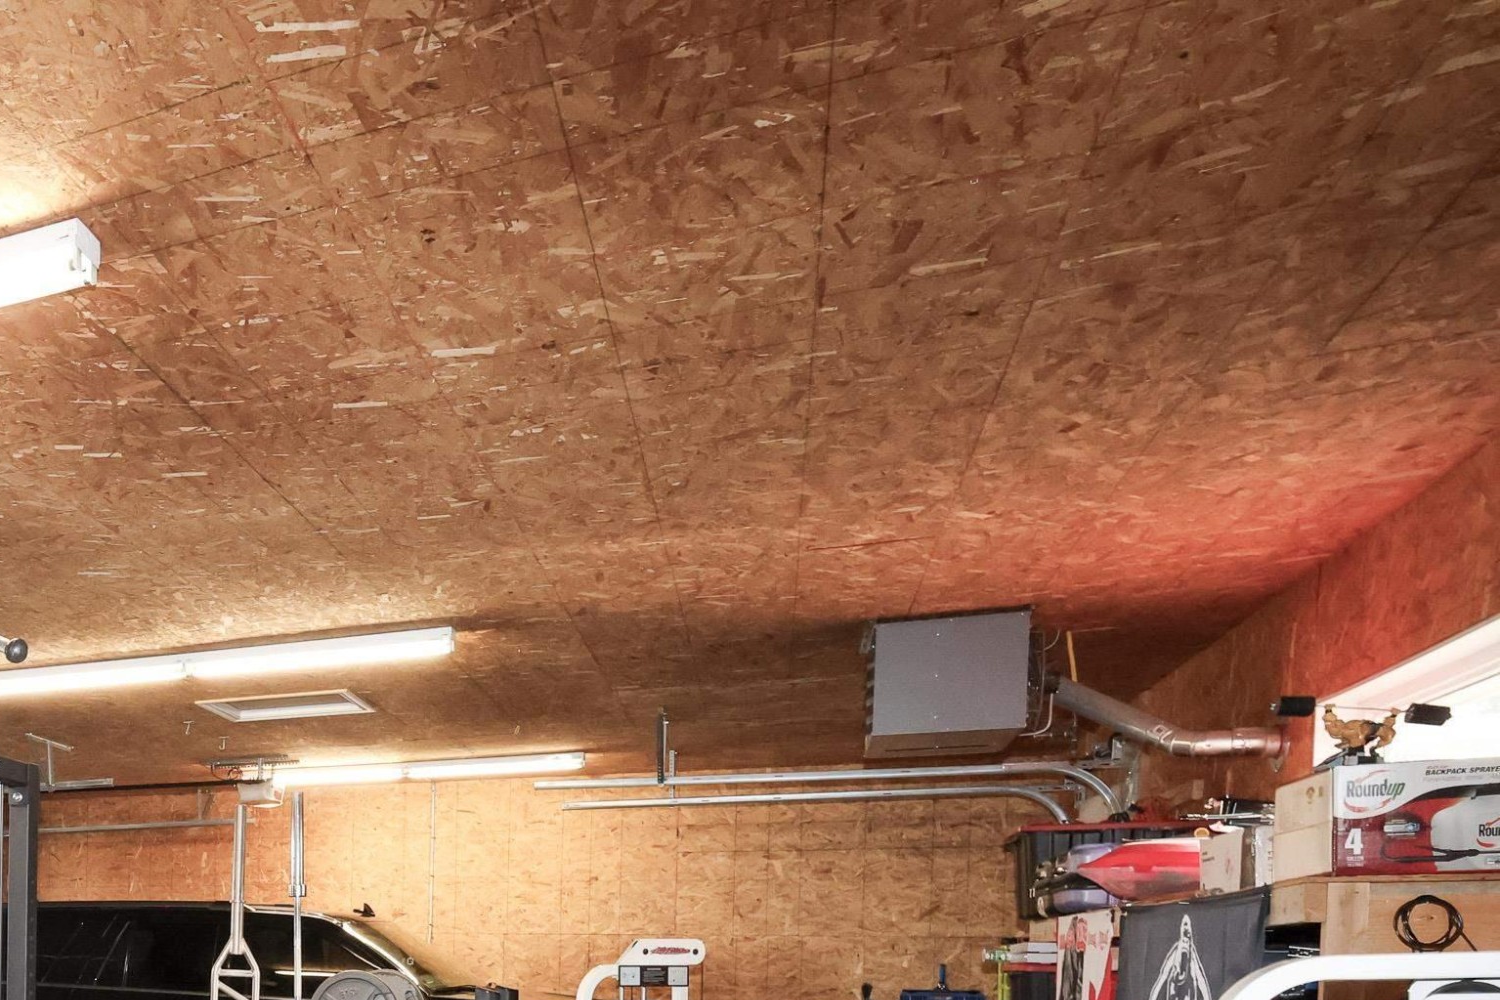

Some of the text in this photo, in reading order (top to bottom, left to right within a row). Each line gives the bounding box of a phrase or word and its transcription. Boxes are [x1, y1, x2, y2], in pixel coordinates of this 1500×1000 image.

[1425, 767, 1467, 776] BACKPACK
[1346, 778, 1406, 800] Roundup
[1344, 828, 1364, 856] 4
